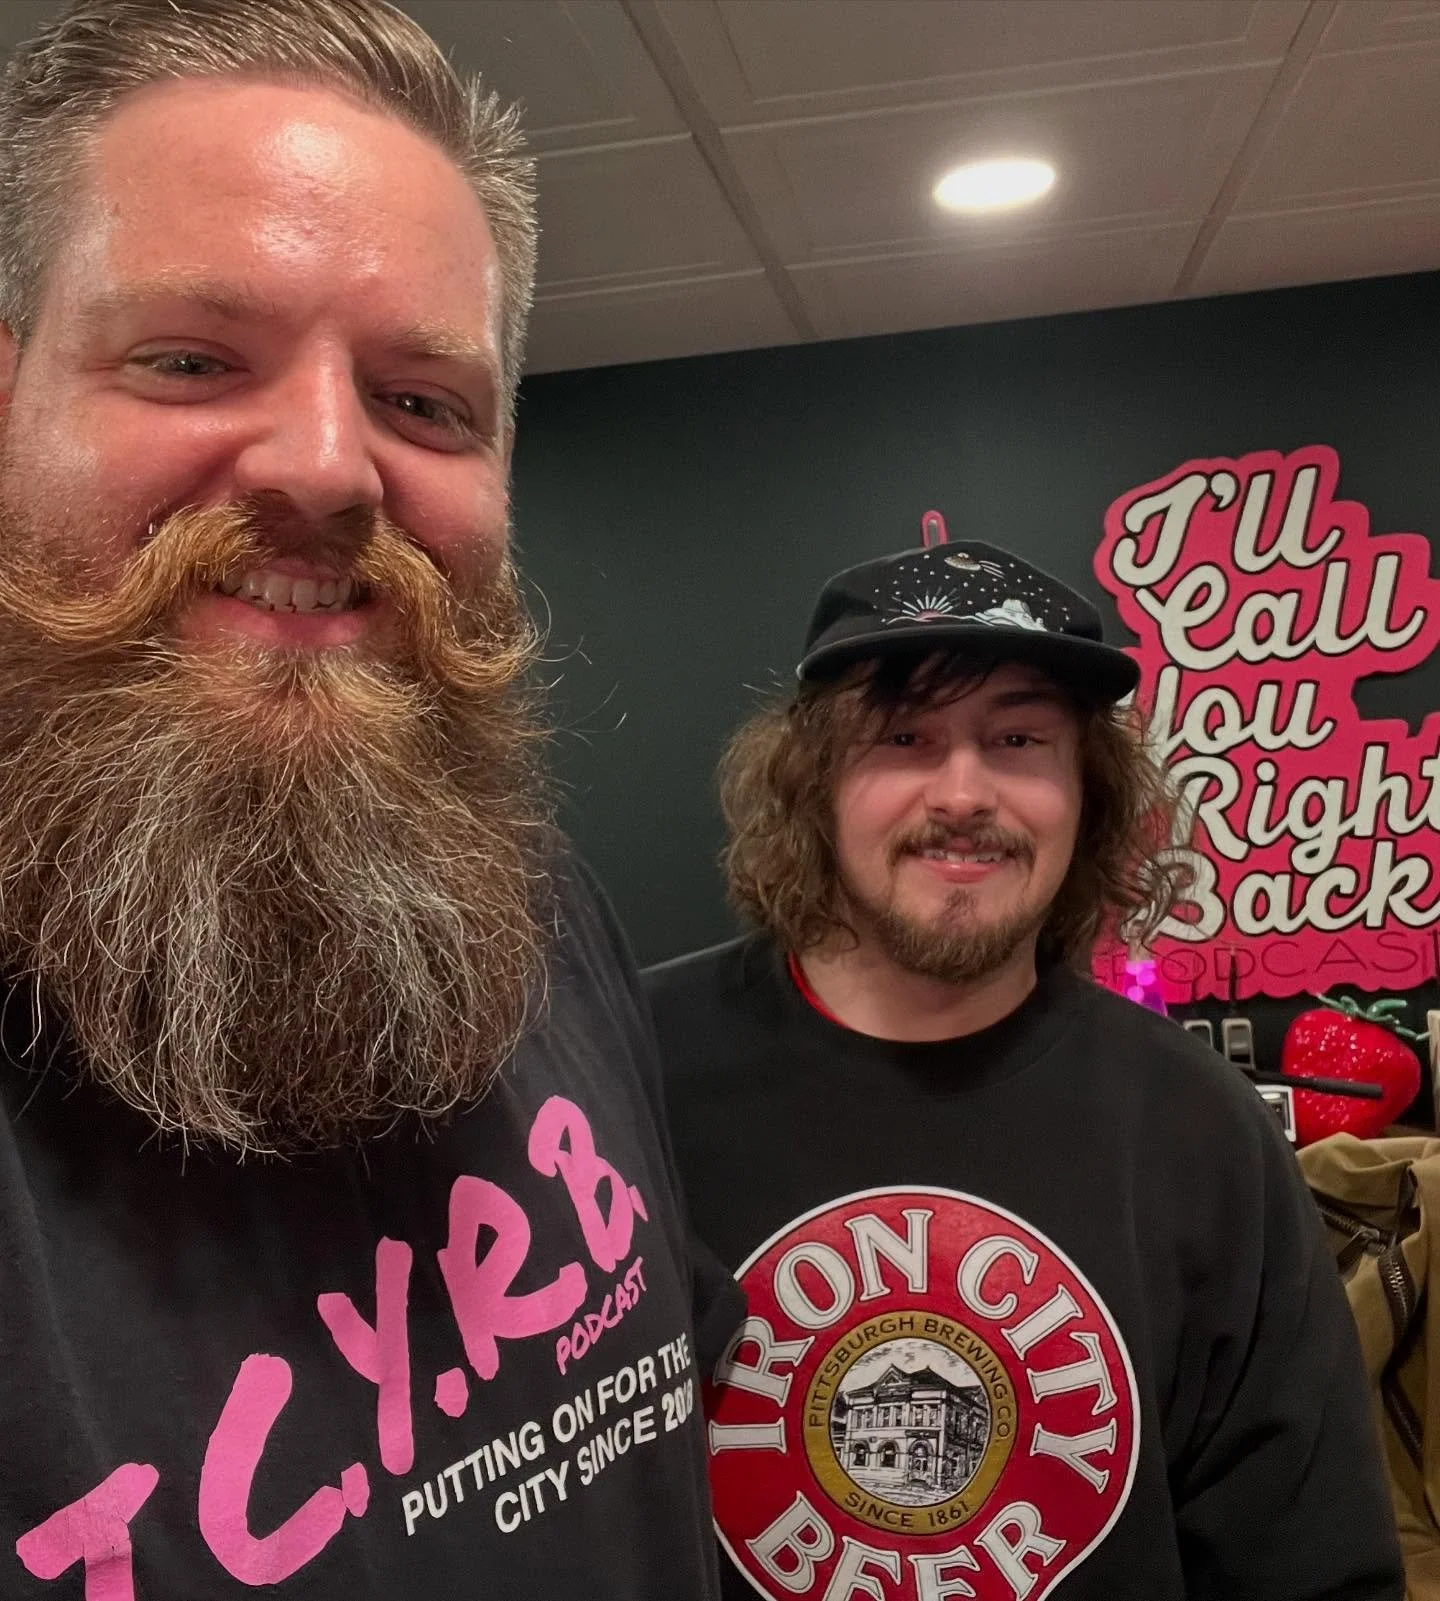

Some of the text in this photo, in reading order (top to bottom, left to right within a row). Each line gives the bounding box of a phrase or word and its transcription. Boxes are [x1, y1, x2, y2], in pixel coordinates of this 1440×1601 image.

[1110, 464, 1342, 588] I'll
[1134, 553, 1426, 671] Call
[1121, 839, 1440, 943] Back
[1111, 925, 1440, 986] PODCAS
[556, 1256, 646, 1375] PODCAST
[708, 1209, 1118, 1494] IRON CITY
[809, 1317, 914, 1428] PITTSBURGH
[924, 1318, 1010, 1400] BREWING
[401, 1332, 691, 1536] PUTTING ON FOR THE
[495, 1460, 570, 1534] CITY
[577, 1405, 657, 1487] SINCE
[844, 1492, 971, 1528] SINCE 1861
